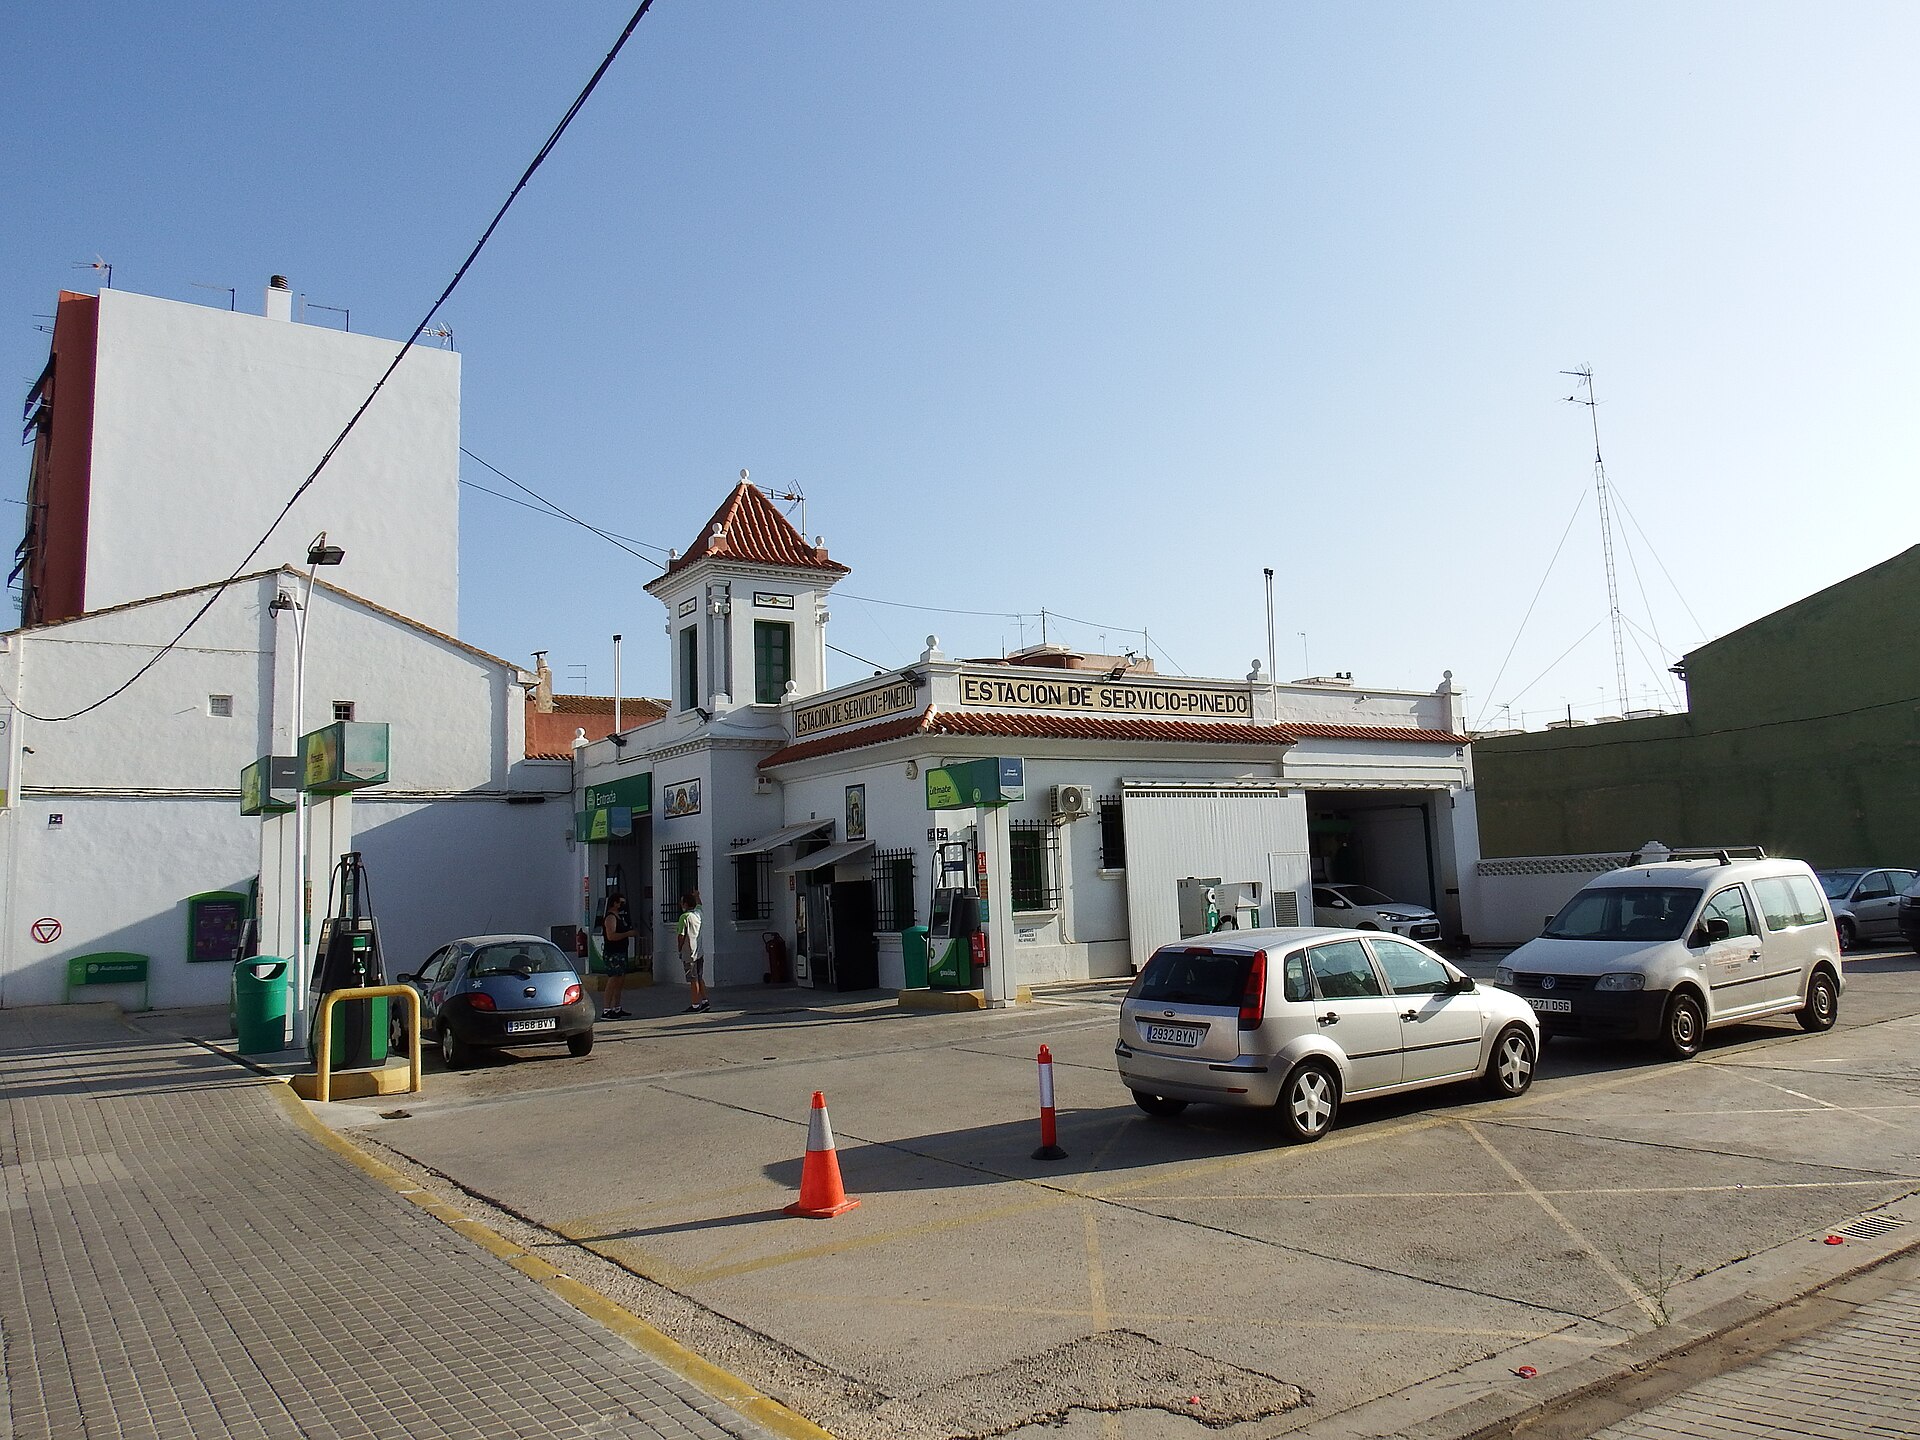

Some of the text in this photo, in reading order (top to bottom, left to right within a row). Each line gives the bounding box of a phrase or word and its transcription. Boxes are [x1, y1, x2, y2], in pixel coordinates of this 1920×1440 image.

[964, 680, 1062, 705] ESTACION
[1067, 687, 1093, 706] DE
[797, 707, 831, 732] ESTACION
[832, 704, 842, 724] DE
[596, 789, 617, 807] Entrada
[1552, 1001, 1570, 1011] DSG
[513, 1021, 536, 1030] 3568
[1152, 1028, 1196, 1043] 2932 BYN
